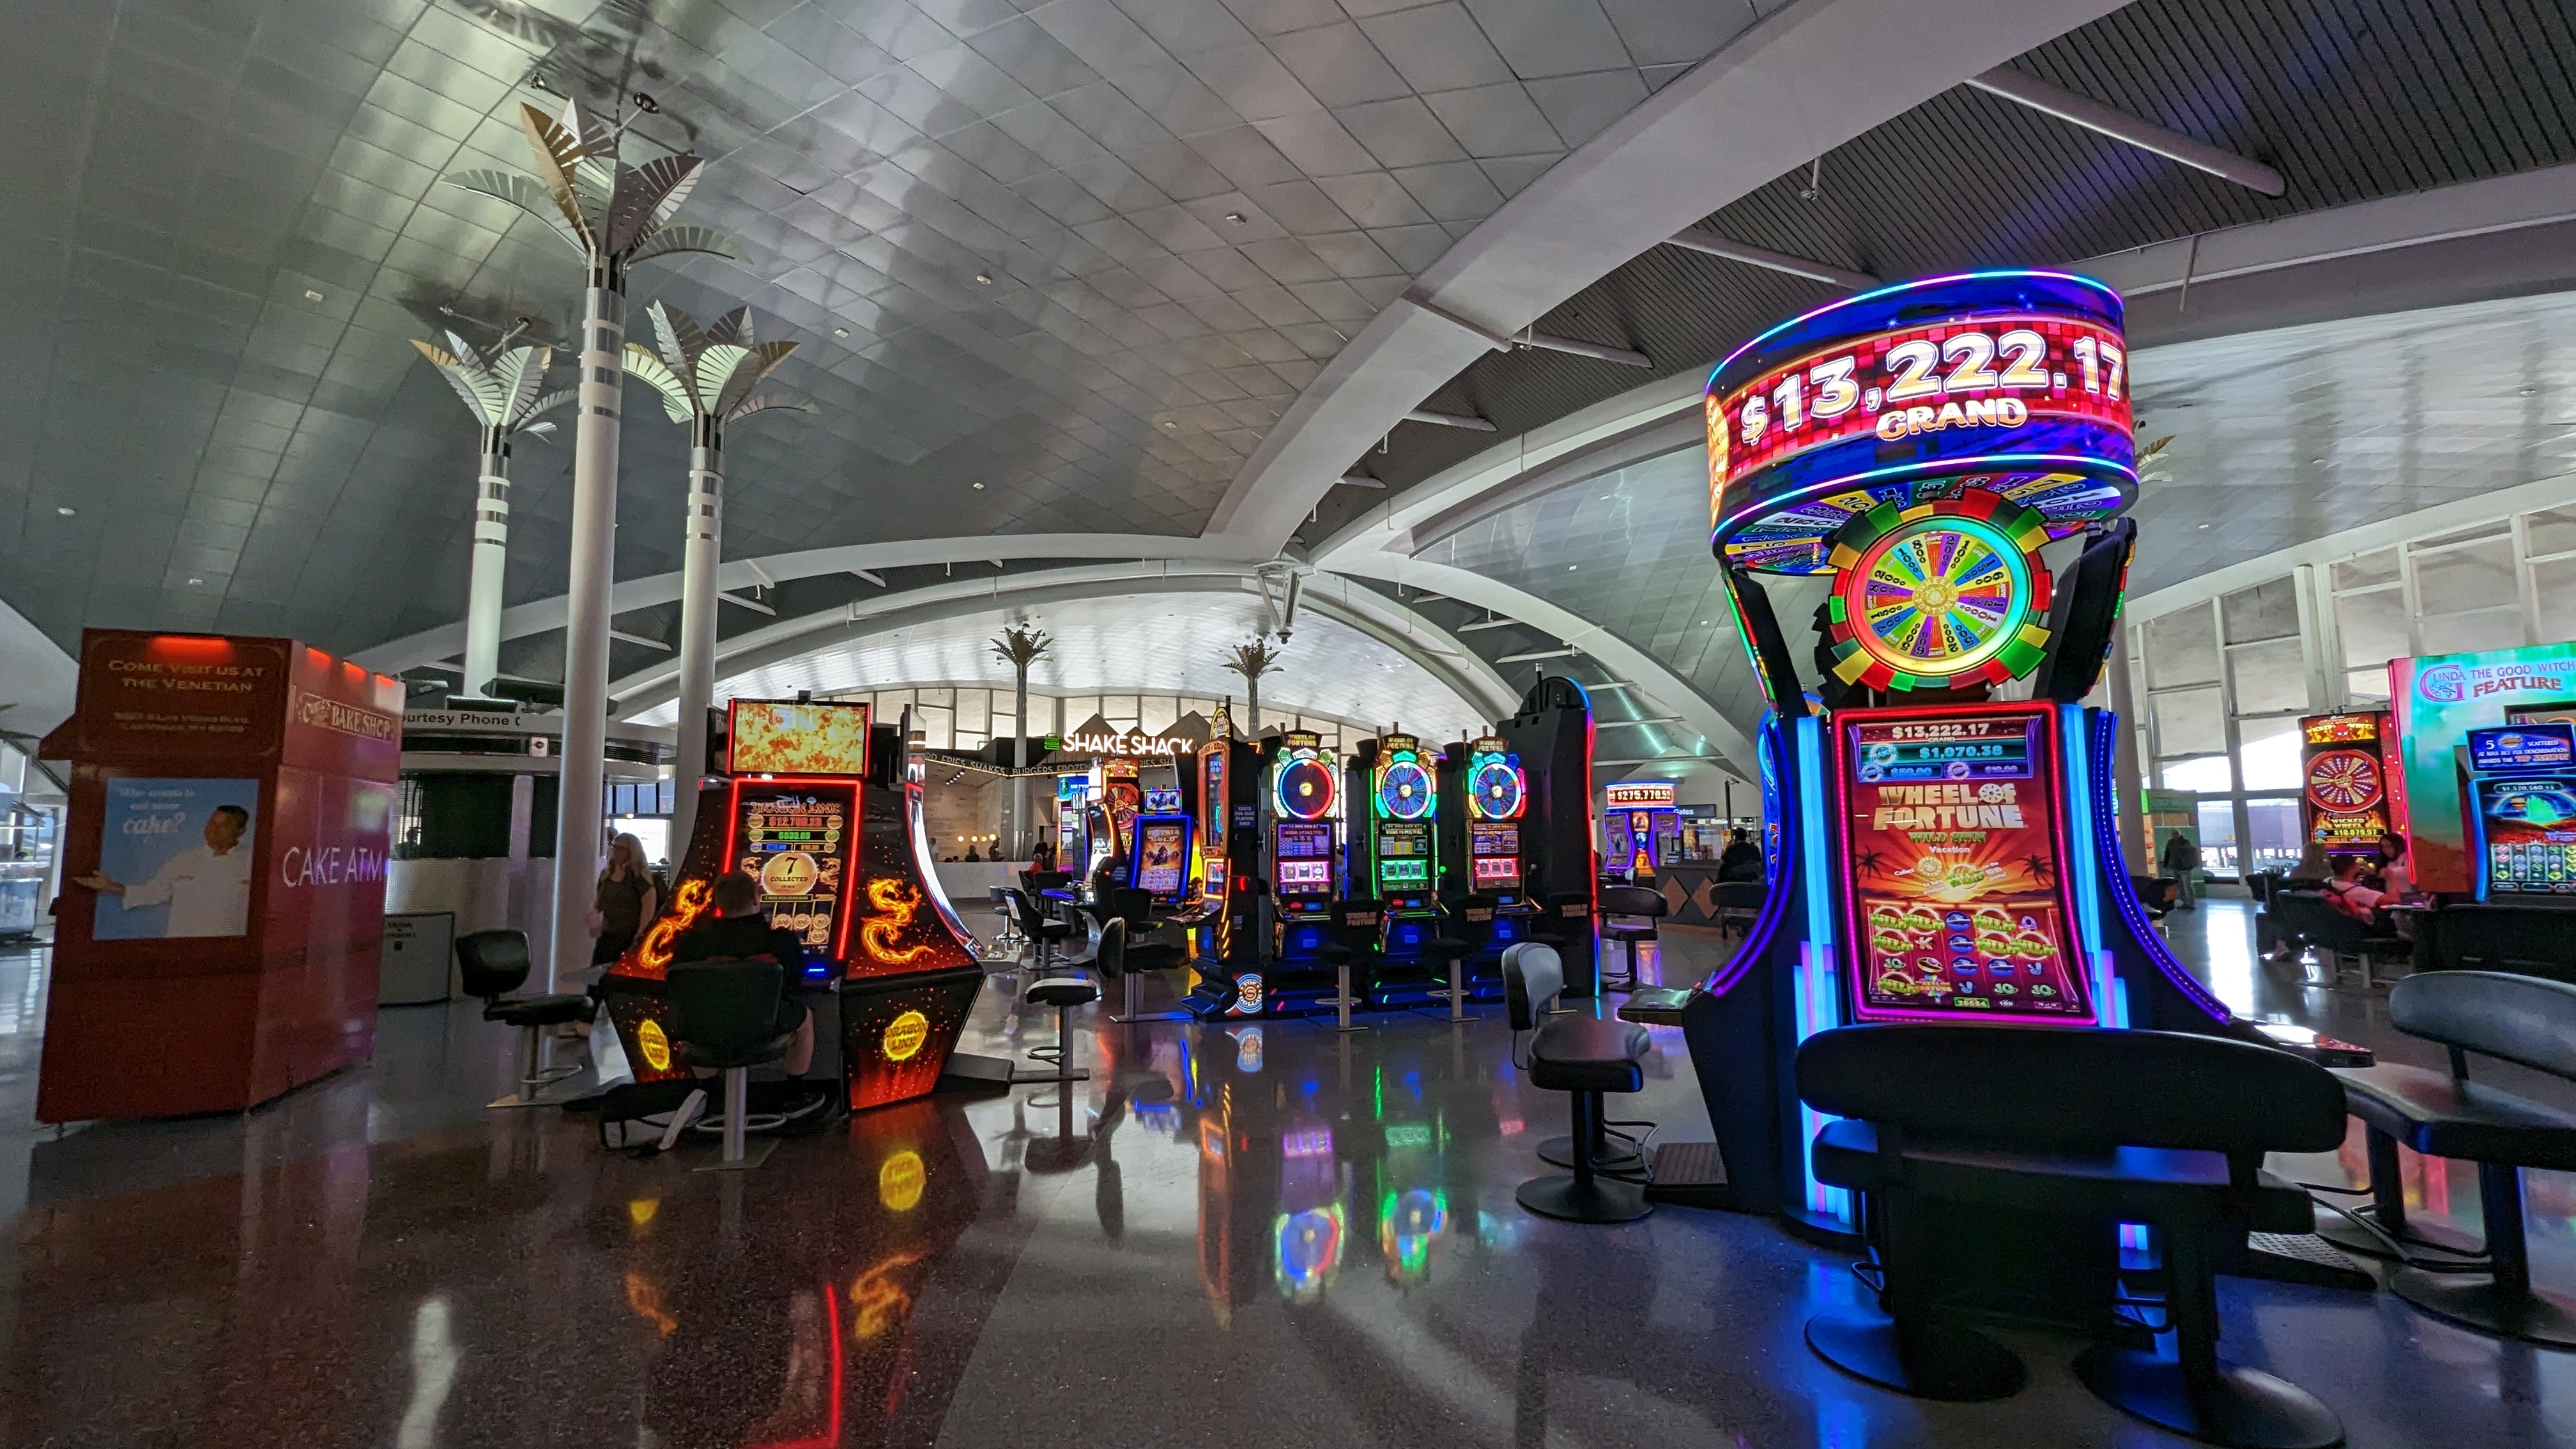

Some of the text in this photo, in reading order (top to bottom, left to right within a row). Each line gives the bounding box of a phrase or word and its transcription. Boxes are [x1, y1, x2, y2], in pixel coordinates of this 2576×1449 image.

[1741, 329, 2124, 445] $13,222.17
[1876, 397, 2027, 441] GRAND
[1897, 548, 1919, 573] 1000
[1912, 540, 1926, 563] 800
[1941, 535, 1955, 567] 2000
[1951, 540, 1970, 569] 1000
[1874, 570, 1906, 586] 2000
[1965, 558, 1997, 579] 1500
[1975, 571, 2004, 585] 600
[1870, 605, 1903, 620] 1500
[1876, 616, 1901, 633] 700
[1900, 623, 1920, 652] 5000
[1943, 624, 1959, 653] 2000
[1955, 624, 1975, 646] 500
[108, 660, 162, 671] COME
[216, 666, 239, 676] US
[241, 668, 266, 677] AT
[2471, 668, 2492, 680] THE
[2496, 664, 2531, 677] GOOD
[2537, 660, 2575, 673] WITCH
[121, 678, 254, 692] THE VENETIAN
[2473, 676, 2563, 698] FEATURE
[332, 705, 362, 733] BAKE
[362, 714, 390, 739] SHOP
[461, 713, 509, 726] Phone
[1892, 723, 1989, 740] $13,222.17
[1062, 733, 1193, 756] SHAKE SHACK
[1919, 745, 2003, 759] $1,070.38
[2485, 740, 2495, 750] 5
[941, 755, 965, 767] FRIES
[970, 761, 1005, 775] SHAKES
[1012, 766, 1053, 776] BURGERS
[1878, 783, 2016, 805] WHEEL OF
[1873, 805, 2024, 831] FORTUNE
[1908, 832, 1947, 843] WILD
[282, 847, 383, 887] CAKE ATM
[785, 857, 799, 875] 7
[1915, 937, 1935, 950] K
[1239, 990, 1262, 1006] DOLLAR
